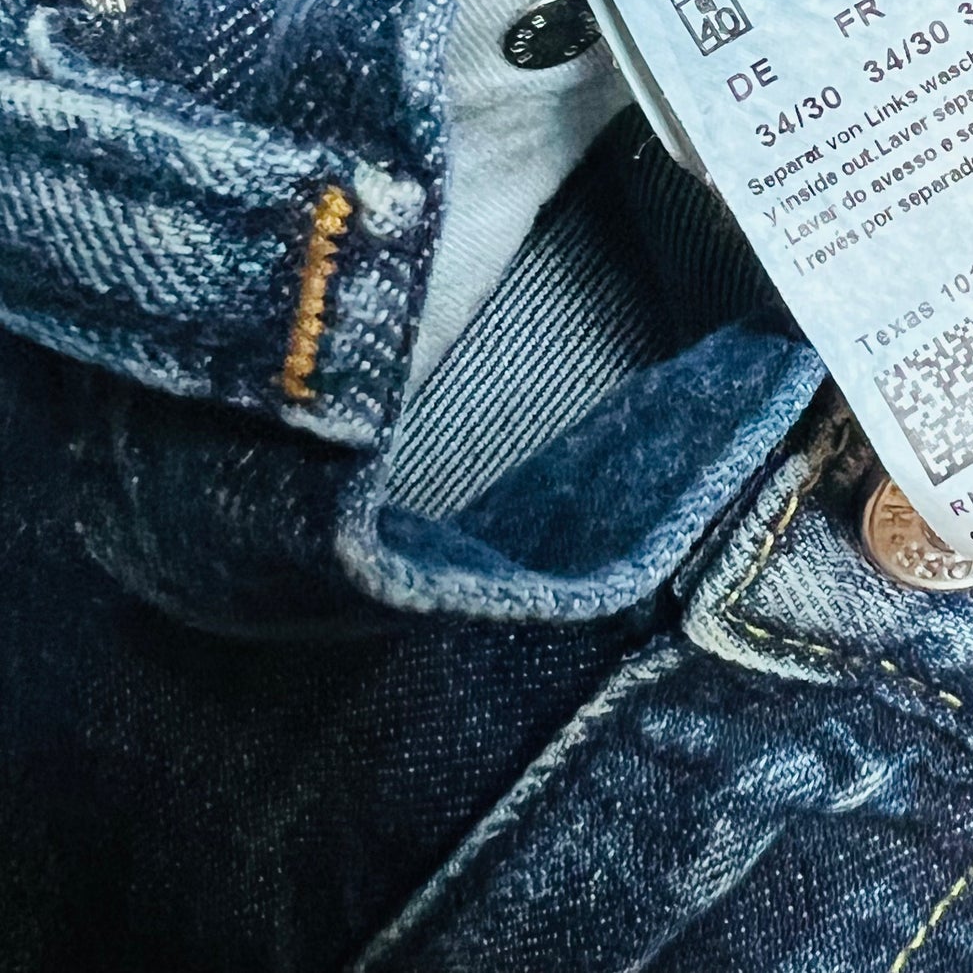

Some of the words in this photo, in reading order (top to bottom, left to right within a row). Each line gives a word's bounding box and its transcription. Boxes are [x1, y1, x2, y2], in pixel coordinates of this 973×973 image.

[726, 57, 778, 102] DE
[755, 86, 842, 147] 34/30
[863, 20, 950, 83] 34/30
[748, 145, 824, 195] Separat
[826, 123, 863, 150] von
[864, 89, 918, 127] Links
[777, 172, 838, 214] inside
[842, 189, 867, 210] do
[871, 147, 938, 193] avesso
[940, 138, 954, 152] e
[861, 205, 894, 239] por
[854, 301, 935, 355] Texas
